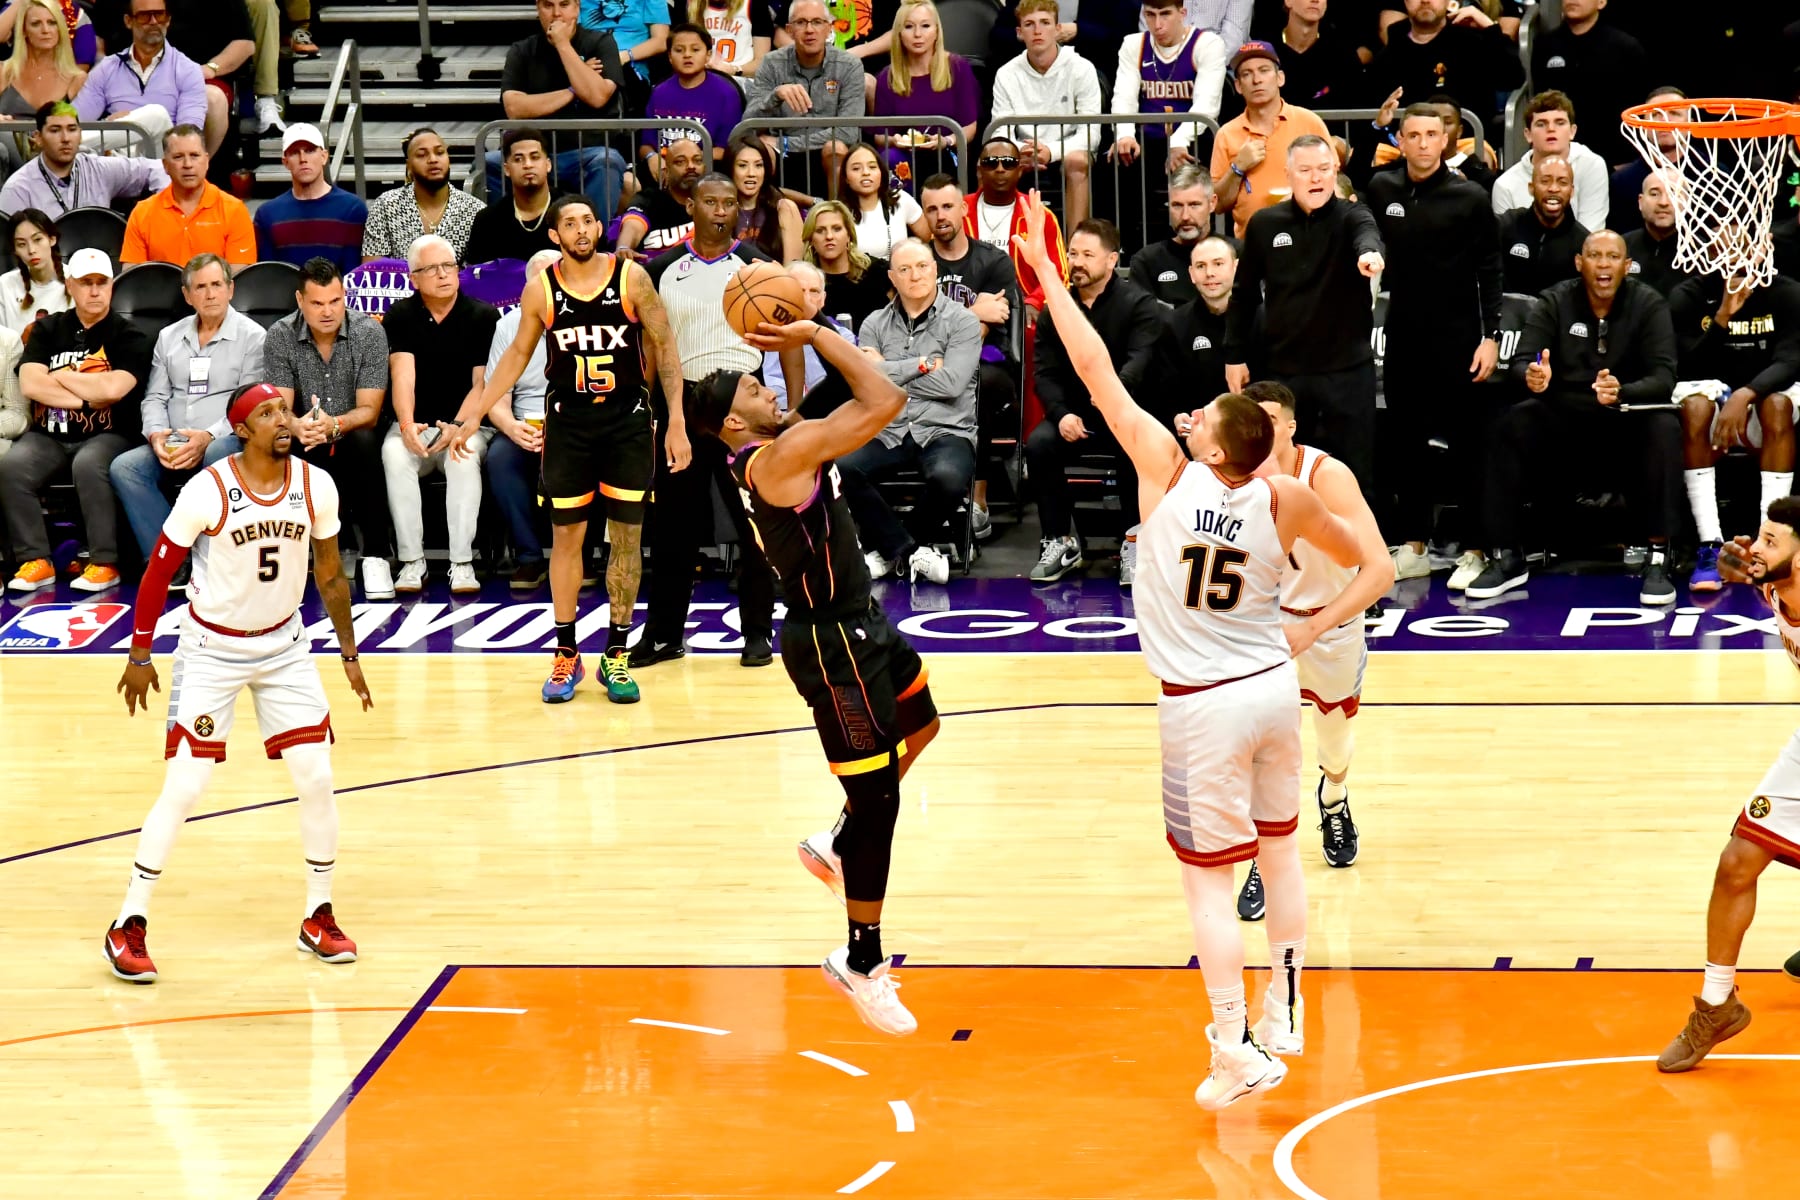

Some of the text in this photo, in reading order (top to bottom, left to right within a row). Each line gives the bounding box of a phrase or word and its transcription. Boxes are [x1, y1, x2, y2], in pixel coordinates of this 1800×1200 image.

[706, 17, 743, 36] OENIX
[643, 221, 695, 249] SUN
[343, 271, 410, 290] RALLY
[344, 296, 404, 313] VALL
[555, 291, 563, 301] 6
[553, 325, 629, 351] PHX
[574, 354, 616, 394] 15
[289, 492, 304, 501] WU
[231, 520, 306, 547] DENVER
[1194, 509, 1244, 542] JOKĆ
[258, 545, 280, 583] 5
[1179, 543, 1250, 613] 15
[110, 603, 788, 649] AYOFFS
[896, 608, 1510, 639] Gole
[0, 637, 50, 647] NBA
